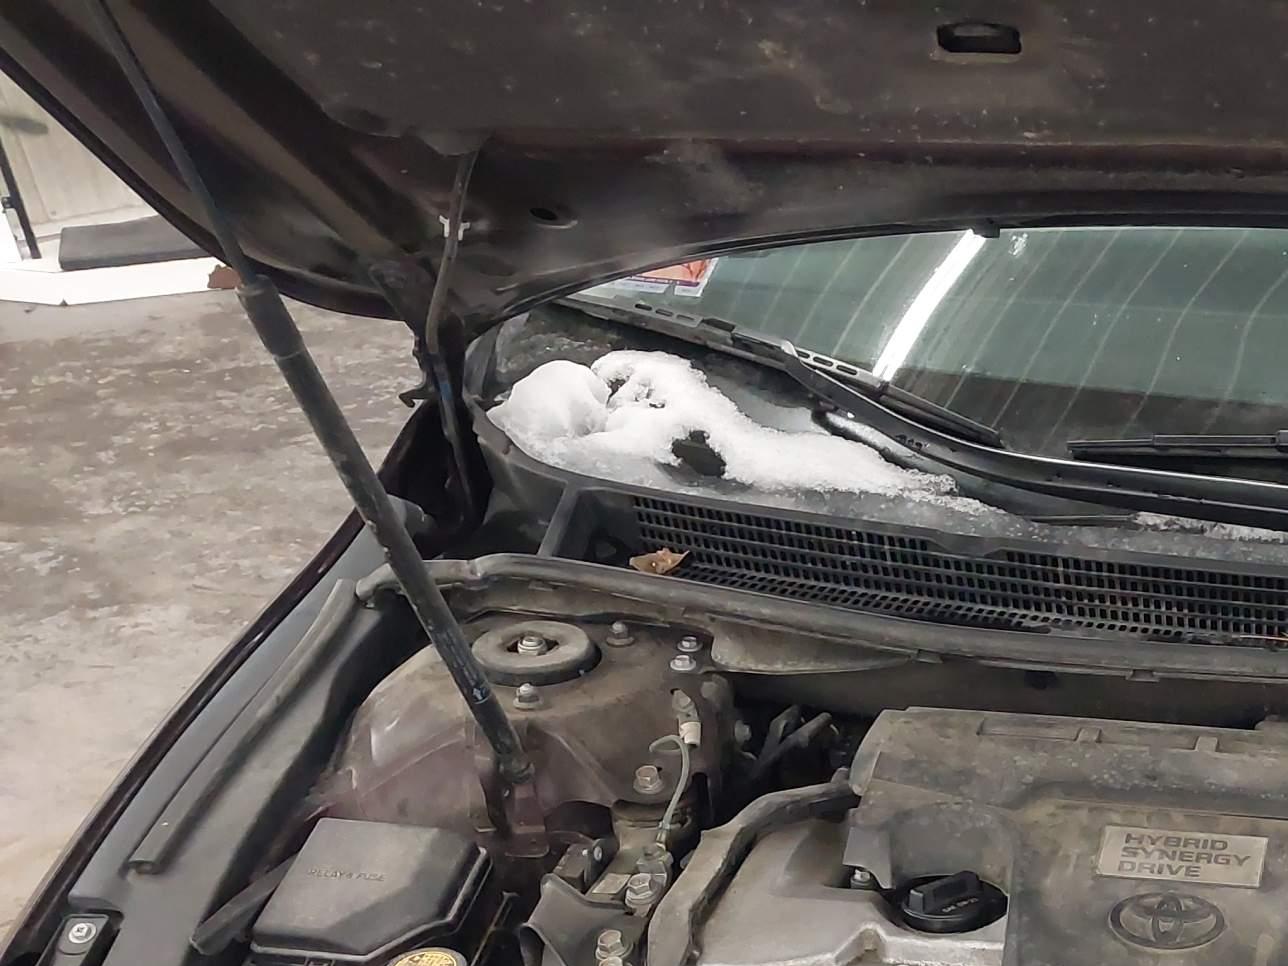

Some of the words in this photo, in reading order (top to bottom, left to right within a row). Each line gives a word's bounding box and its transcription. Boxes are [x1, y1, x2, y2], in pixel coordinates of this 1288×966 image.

[1125, 833, 1228, 850] HYBRID
[1121, 846, 1251, 867] SYNERGY
[1118, 860, 1202, 878] DRIVE
